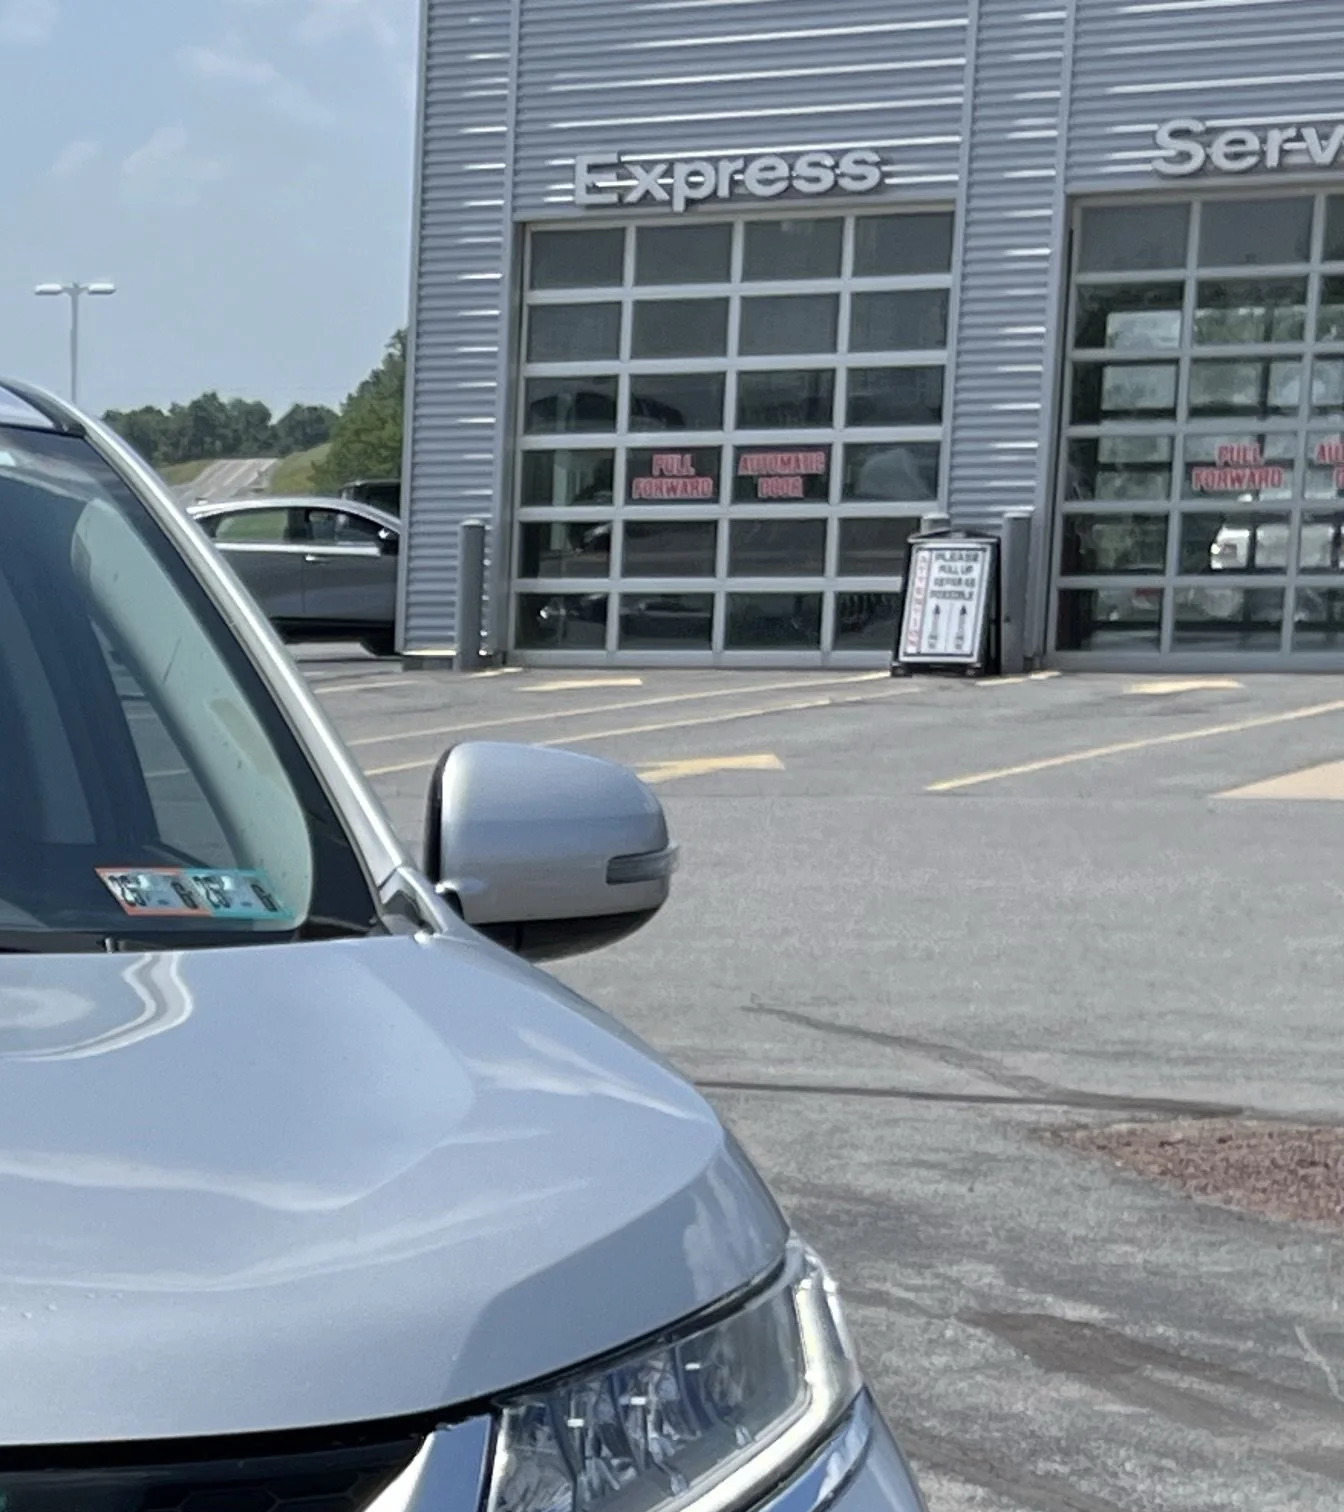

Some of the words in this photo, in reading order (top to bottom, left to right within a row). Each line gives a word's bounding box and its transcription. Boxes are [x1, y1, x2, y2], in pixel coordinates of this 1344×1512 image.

[1151, 117, 1344, 175] Serv
[574, 149, 882, 213] Express
[652, 454, 696, 476] PULL
[738, 452, 826, 475] AUTOMATIC
[632, 477, 713, 499] FORWARD
[1192, 466, 1284, 491] FORWARD
